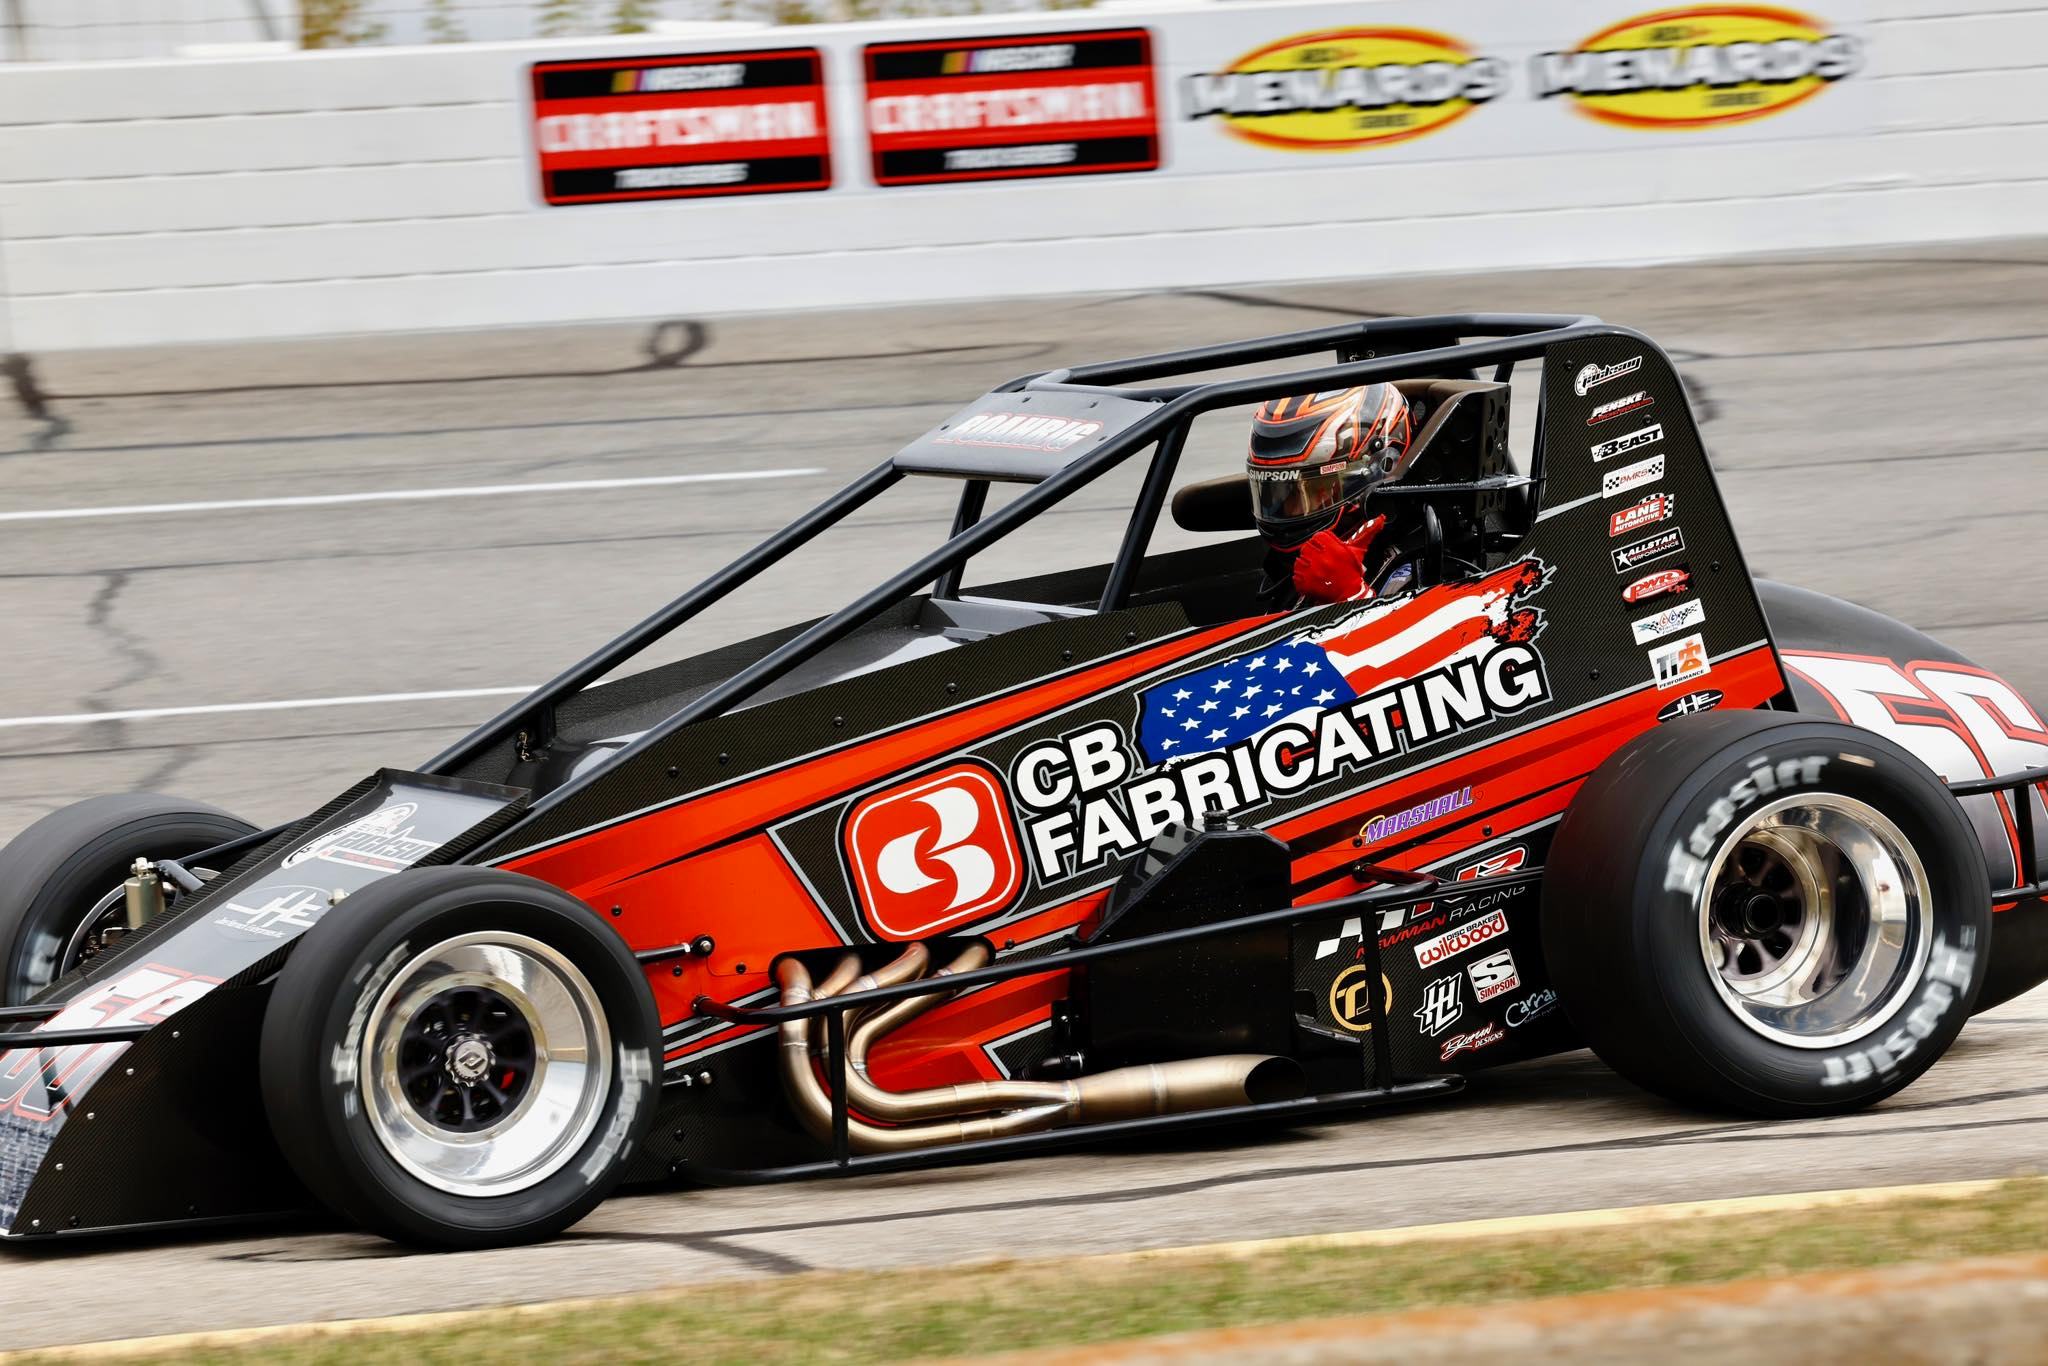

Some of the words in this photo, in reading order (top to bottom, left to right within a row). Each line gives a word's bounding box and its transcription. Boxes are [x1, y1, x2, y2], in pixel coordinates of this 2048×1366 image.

[1249, 469, 1300, 481] SIMPSON
[1614, 500, 1661, 526] LANE
[1614, 510, 1660, 533] AUTOMOTIVE
[1627, 533, 1677, 557] ALLSTAR
[1629, 541, 1680, 563] PERFORMANCE
[1659, 669, 1705, 688] PERFORMANCE
[1018, 729, 1128, 813] CB
[1032, 646, 1546, 878] FABRICATING
[1366, 785, 1473, 845] MARSHALL
[1450, 885, 1526, 921] RACING
[1447, 928, 1465, 941] DISC
[1466, 912, 1499, 931] BRAKES
[1480, 977, 1516, 1000] SIMPSON
[1474, 1030, 1504, 1049] DESIGNS
